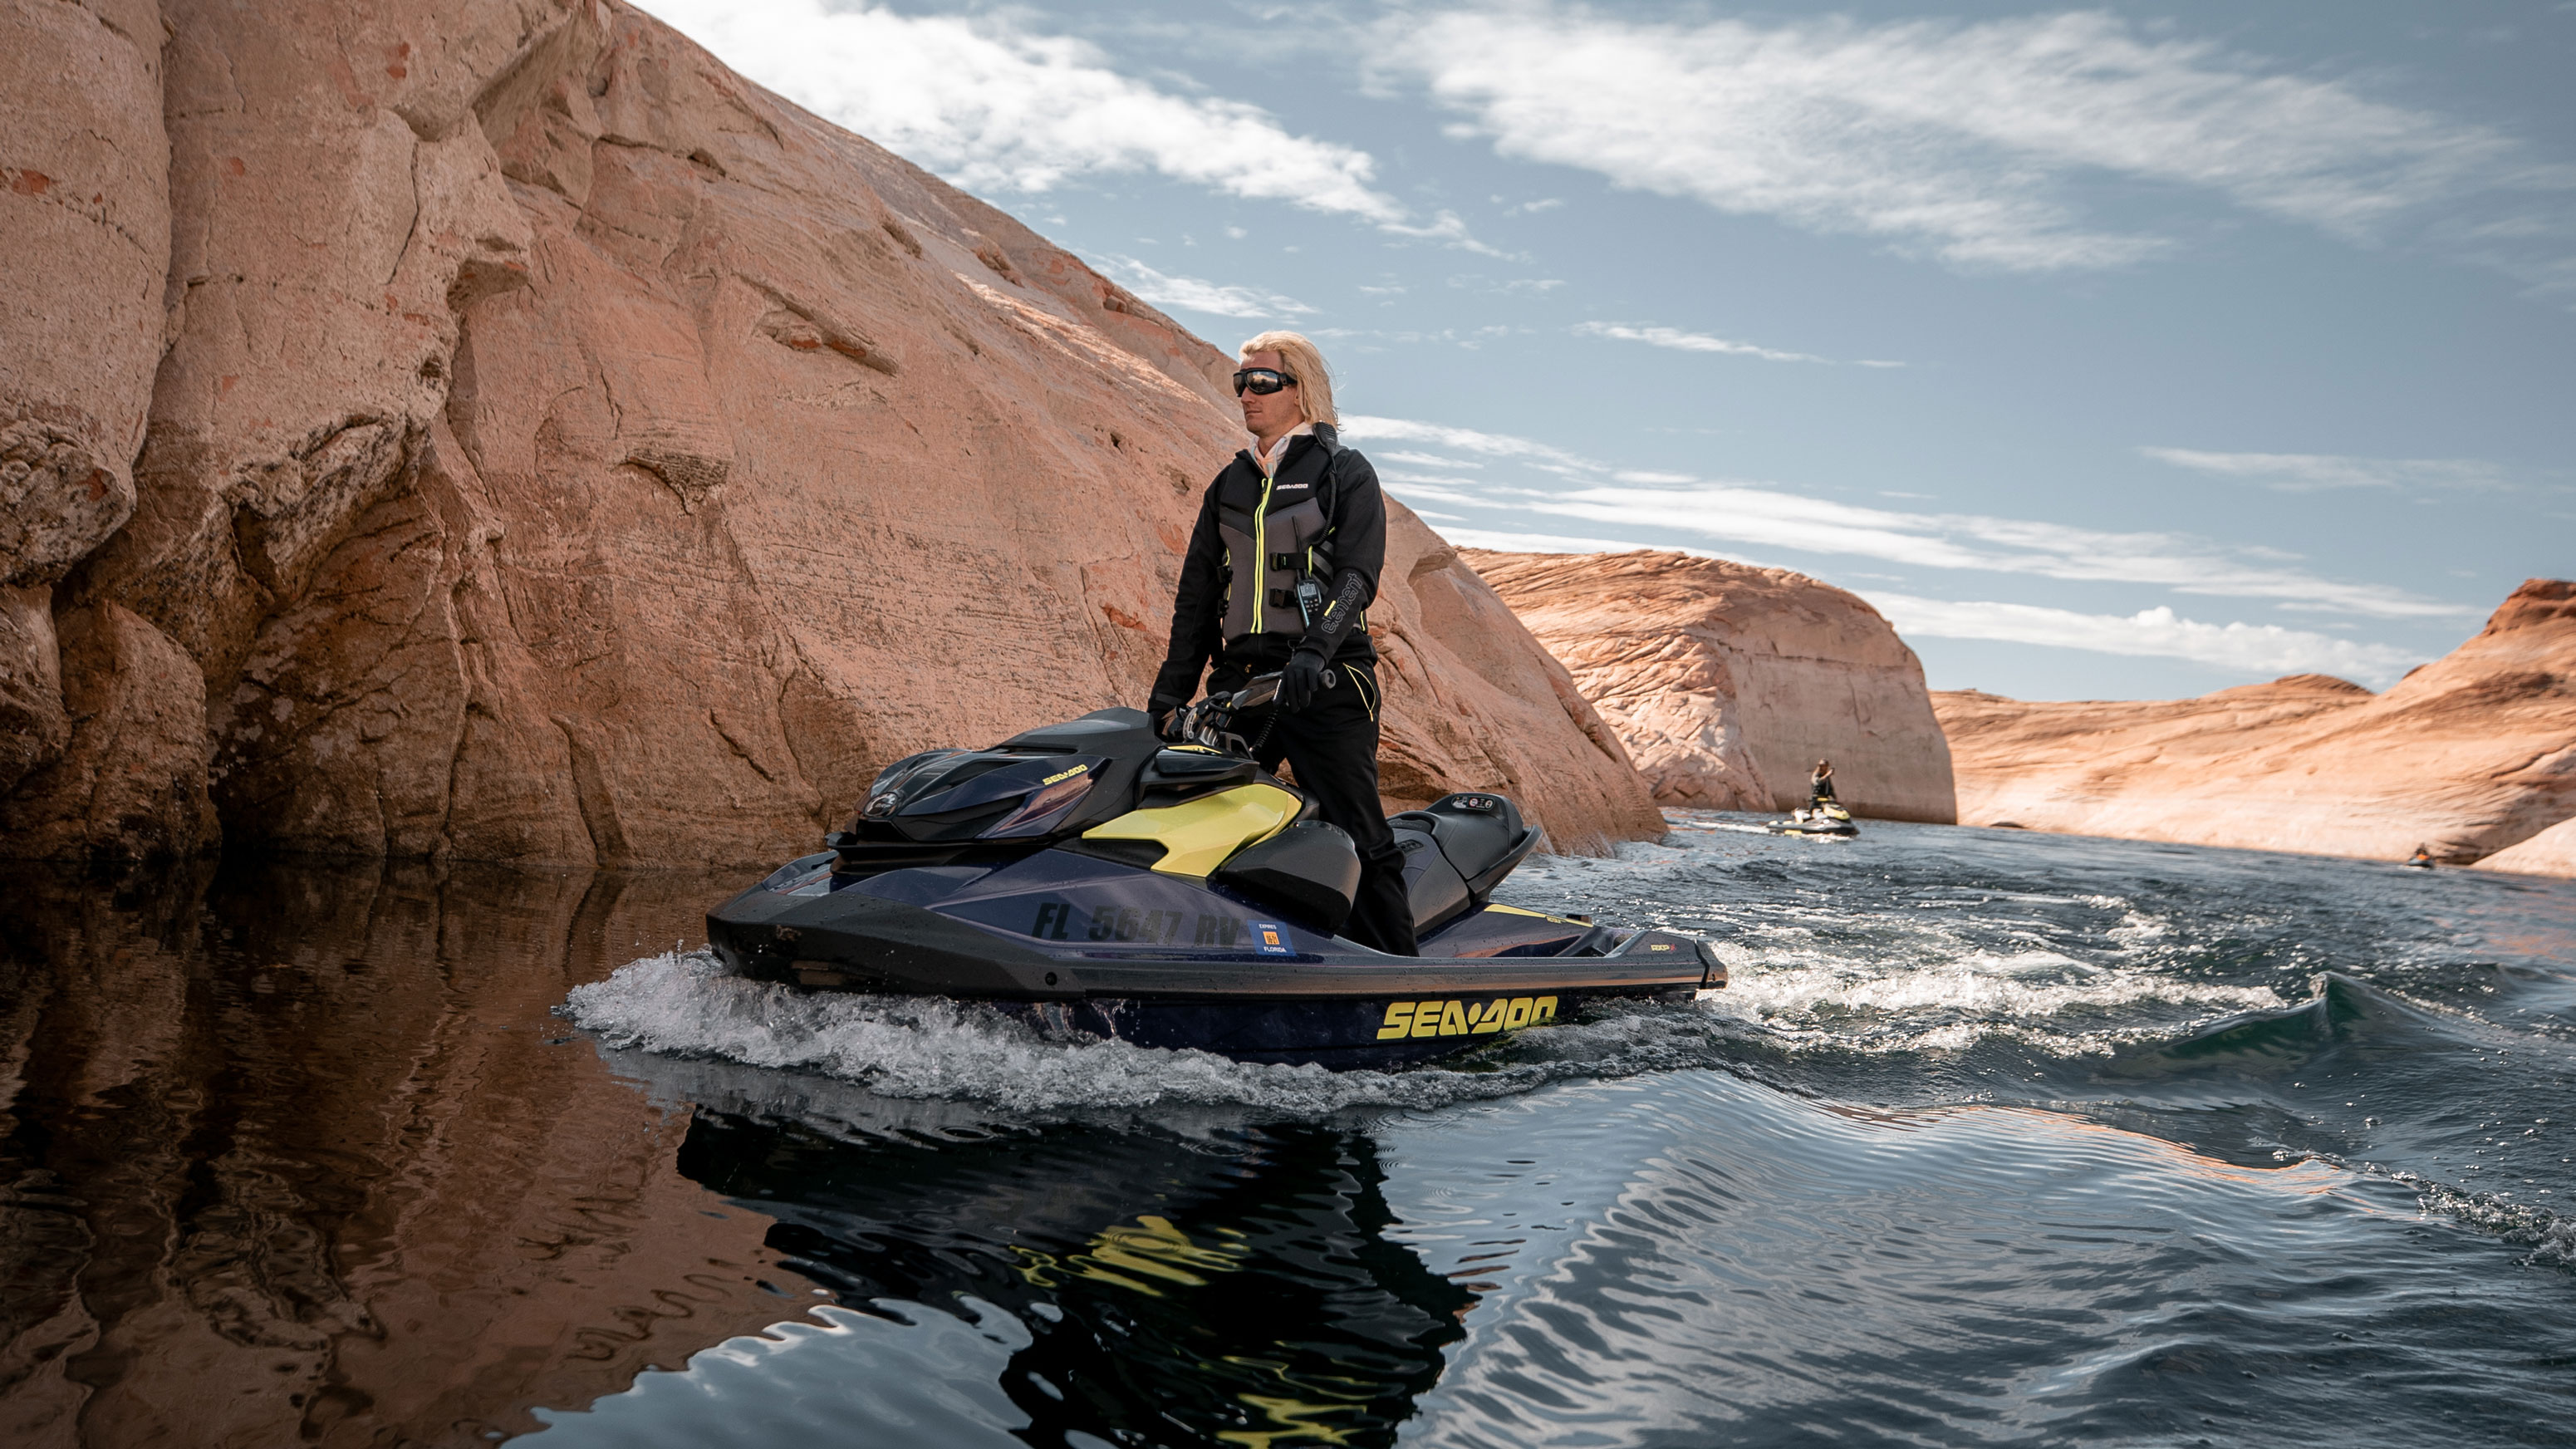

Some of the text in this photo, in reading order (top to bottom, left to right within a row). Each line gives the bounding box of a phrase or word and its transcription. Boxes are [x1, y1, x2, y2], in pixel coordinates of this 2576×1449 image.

[1321, 572, 1363, 634] element
[1031, 902, 1241, 946] FL 5647 RV
